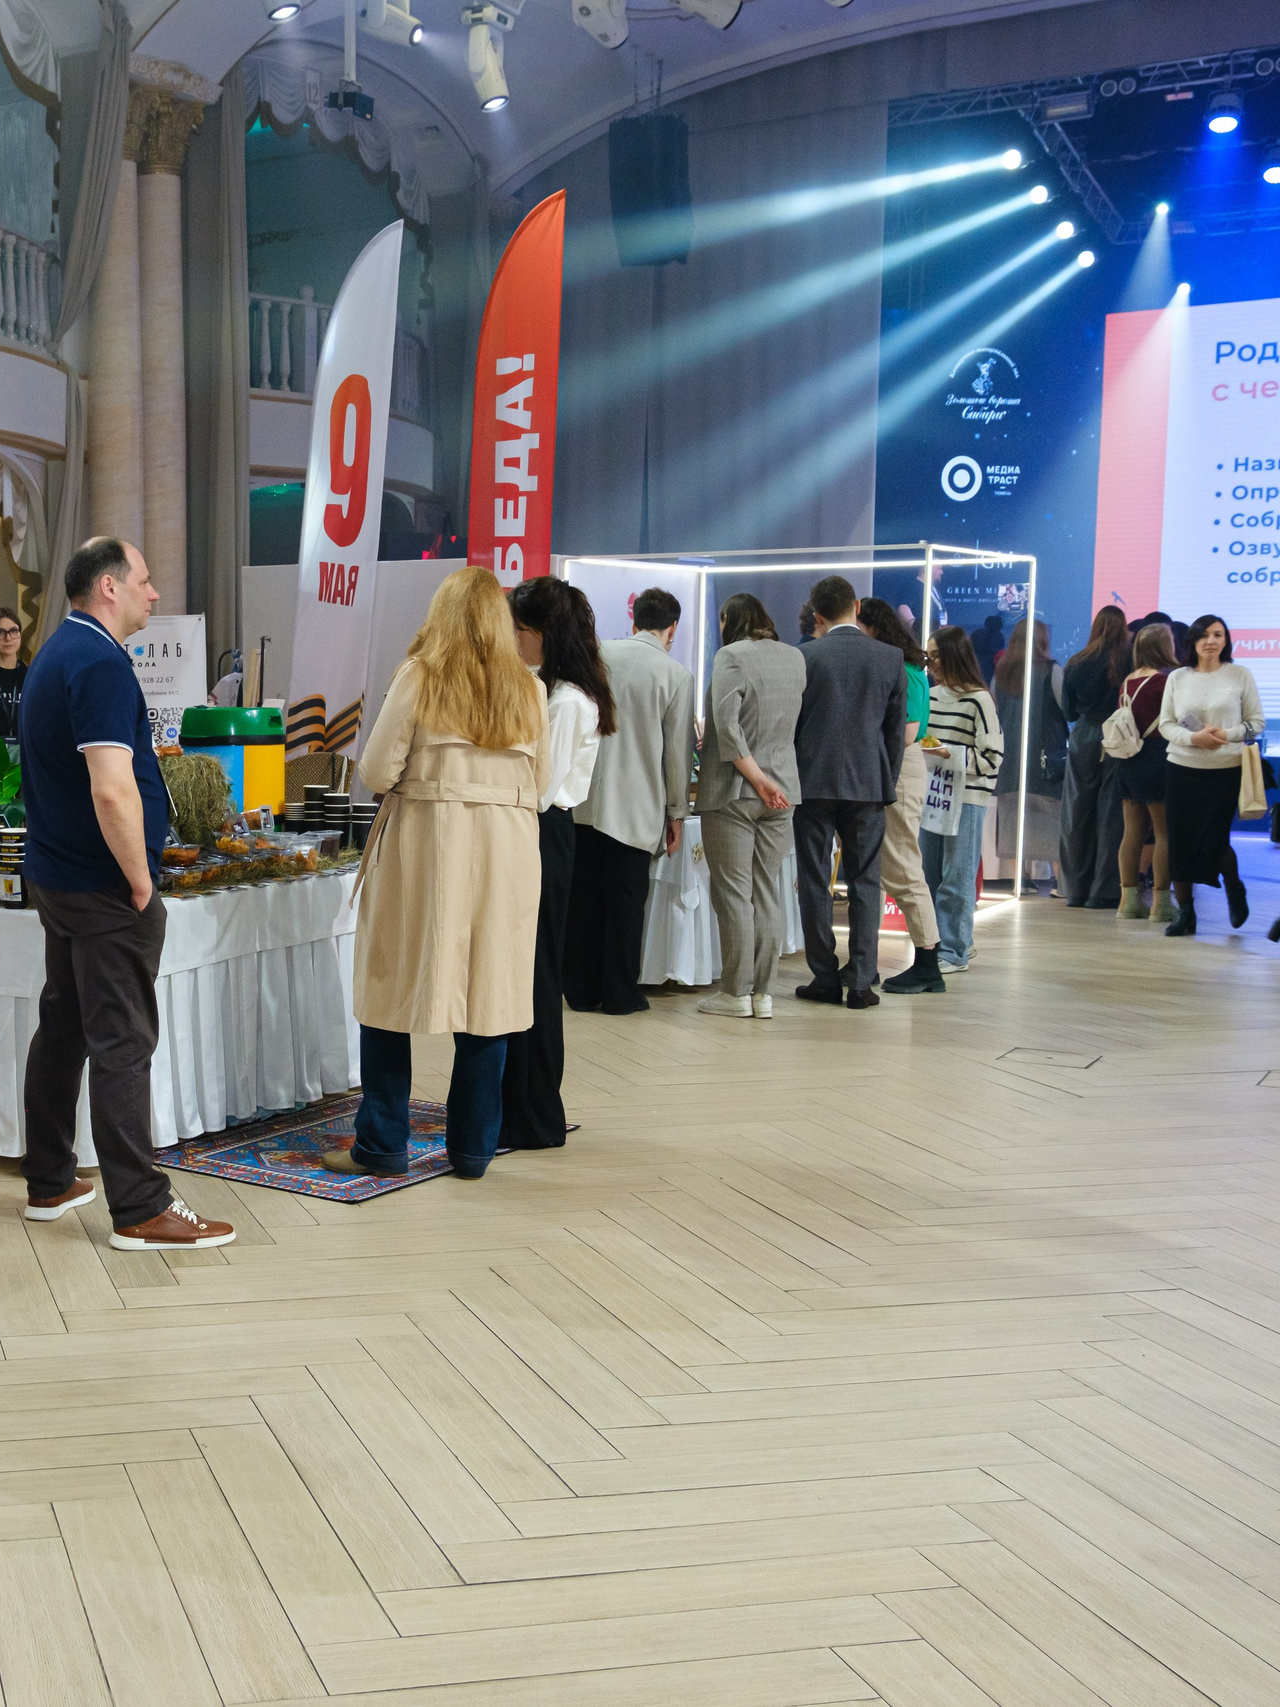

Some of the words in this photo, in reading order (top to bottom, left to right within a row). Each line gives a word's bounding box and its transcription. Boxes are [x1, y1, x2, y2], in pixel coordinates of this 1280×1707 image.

[1215, 341, 1280, 365] Род
[1212, 383, 1229, 402] с
[1240, 380, 1280, 399] че
[323, 374, 371, 547] 9
[1234, 457, 1280, 472] Наз
[494, 353, 539, 588] БЕДА!
[986, 465, 1021, 475] МЕДИА
[988, 475, 1018, 485] ТРАСТ
[1232, 485, 1279, 502] Опр
[318, 561, 359, 608] МАЯ
[1227, 567, 1280, 586] собр
[946, 587, 980, 595] GREEN
[986, 587, 998, 595] MI
[1232, 640, 1280, 653] учит
[930, 780, 953, 796] ЦП
